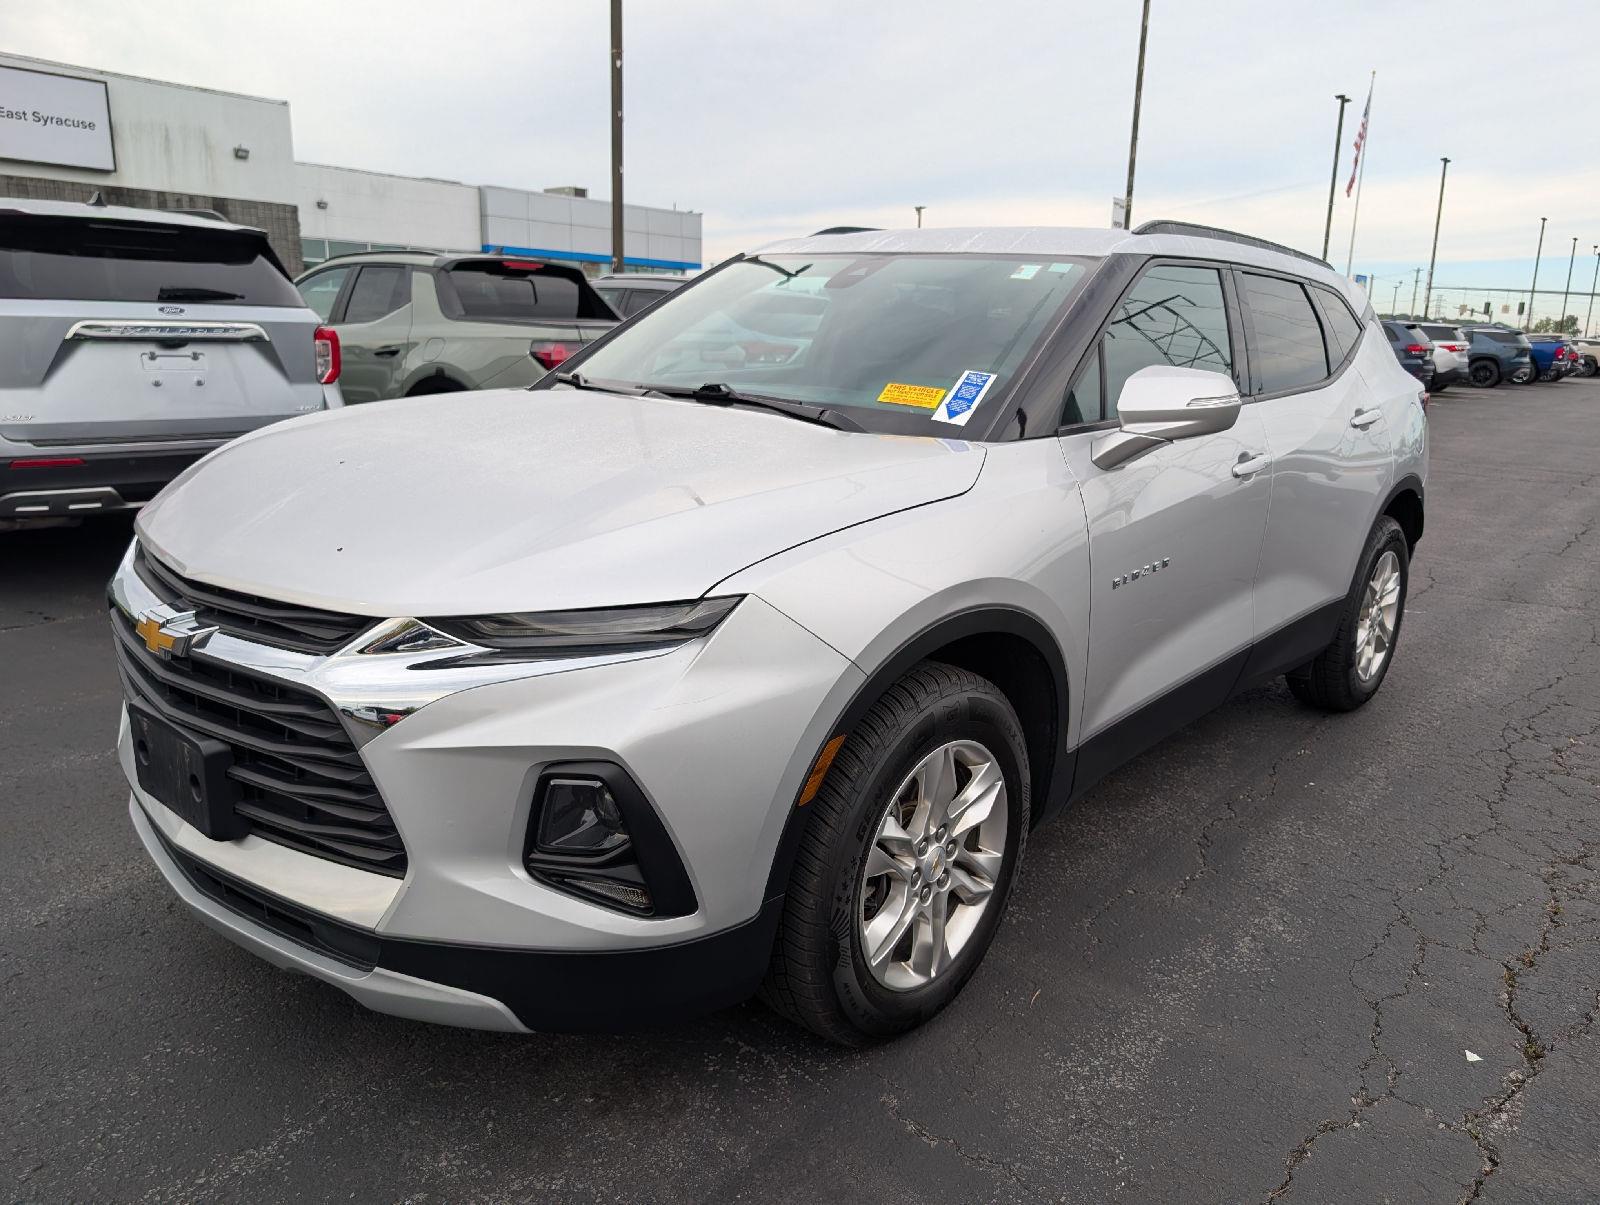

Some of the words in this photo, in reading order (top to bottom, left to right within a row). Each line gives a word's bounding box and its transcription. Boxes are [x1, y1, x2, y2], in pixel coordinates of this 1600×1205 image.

[0, 106, 28, 121] East
[32, 111, 96, 131] Syracuse
[909, 386, 940, 395] VEHICLE
[1112, 557, 1170, 590] BLAZER
